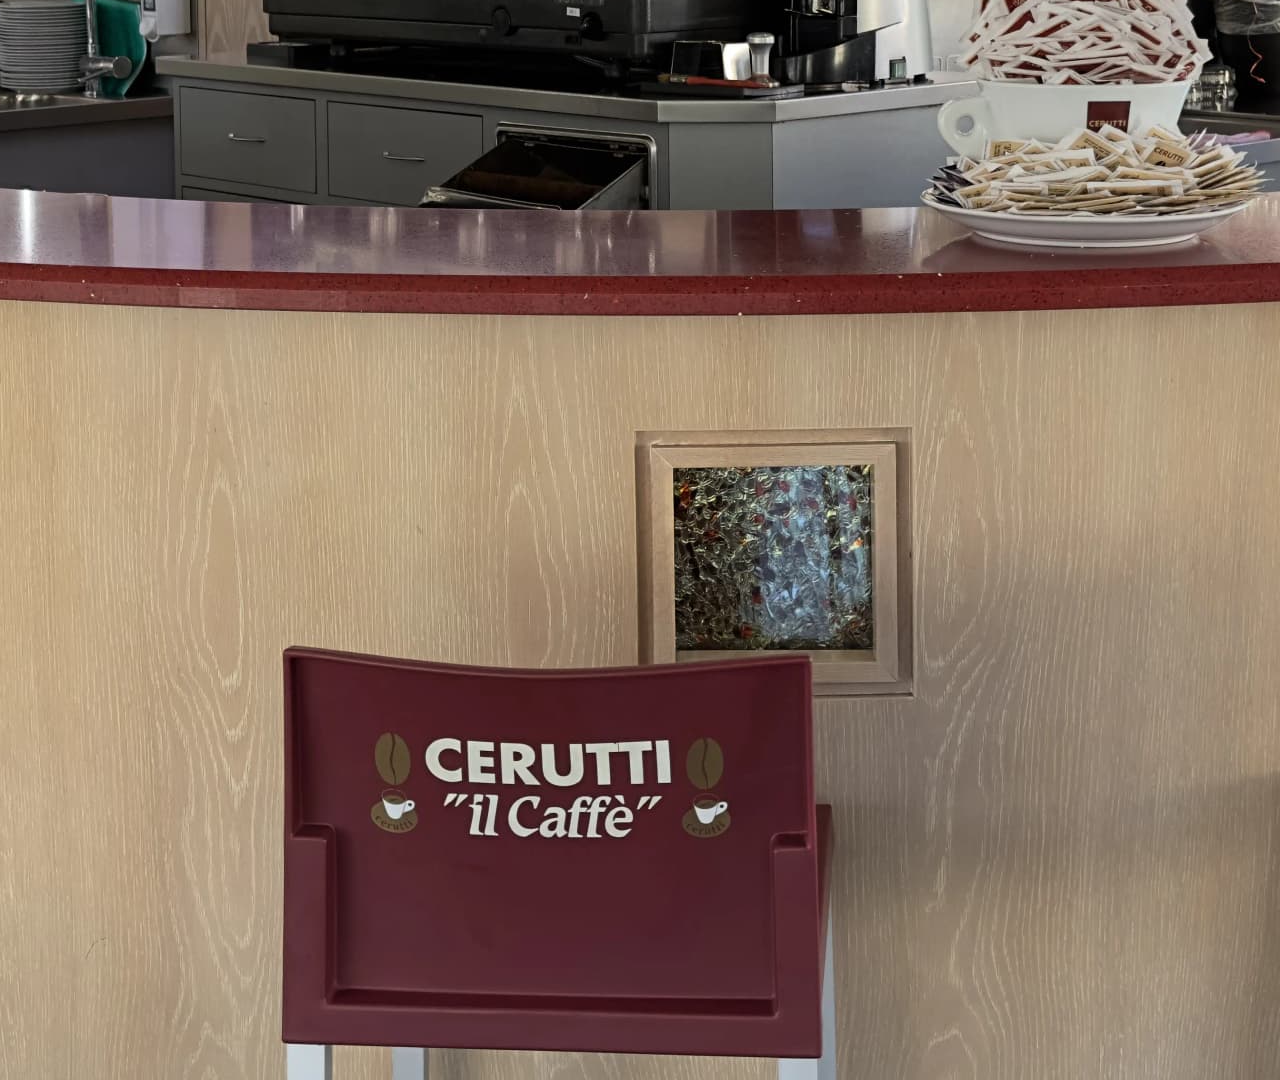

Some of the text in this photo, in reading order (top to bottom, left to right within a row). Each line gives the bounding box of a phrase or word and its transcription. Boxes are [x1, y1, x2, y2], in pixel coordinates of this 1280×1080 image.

[1153, 146, 1185, 163] CERUTTI
[424, 737, 672, 787] CERUTTI
[375, 814, 414, 831] cerutti
